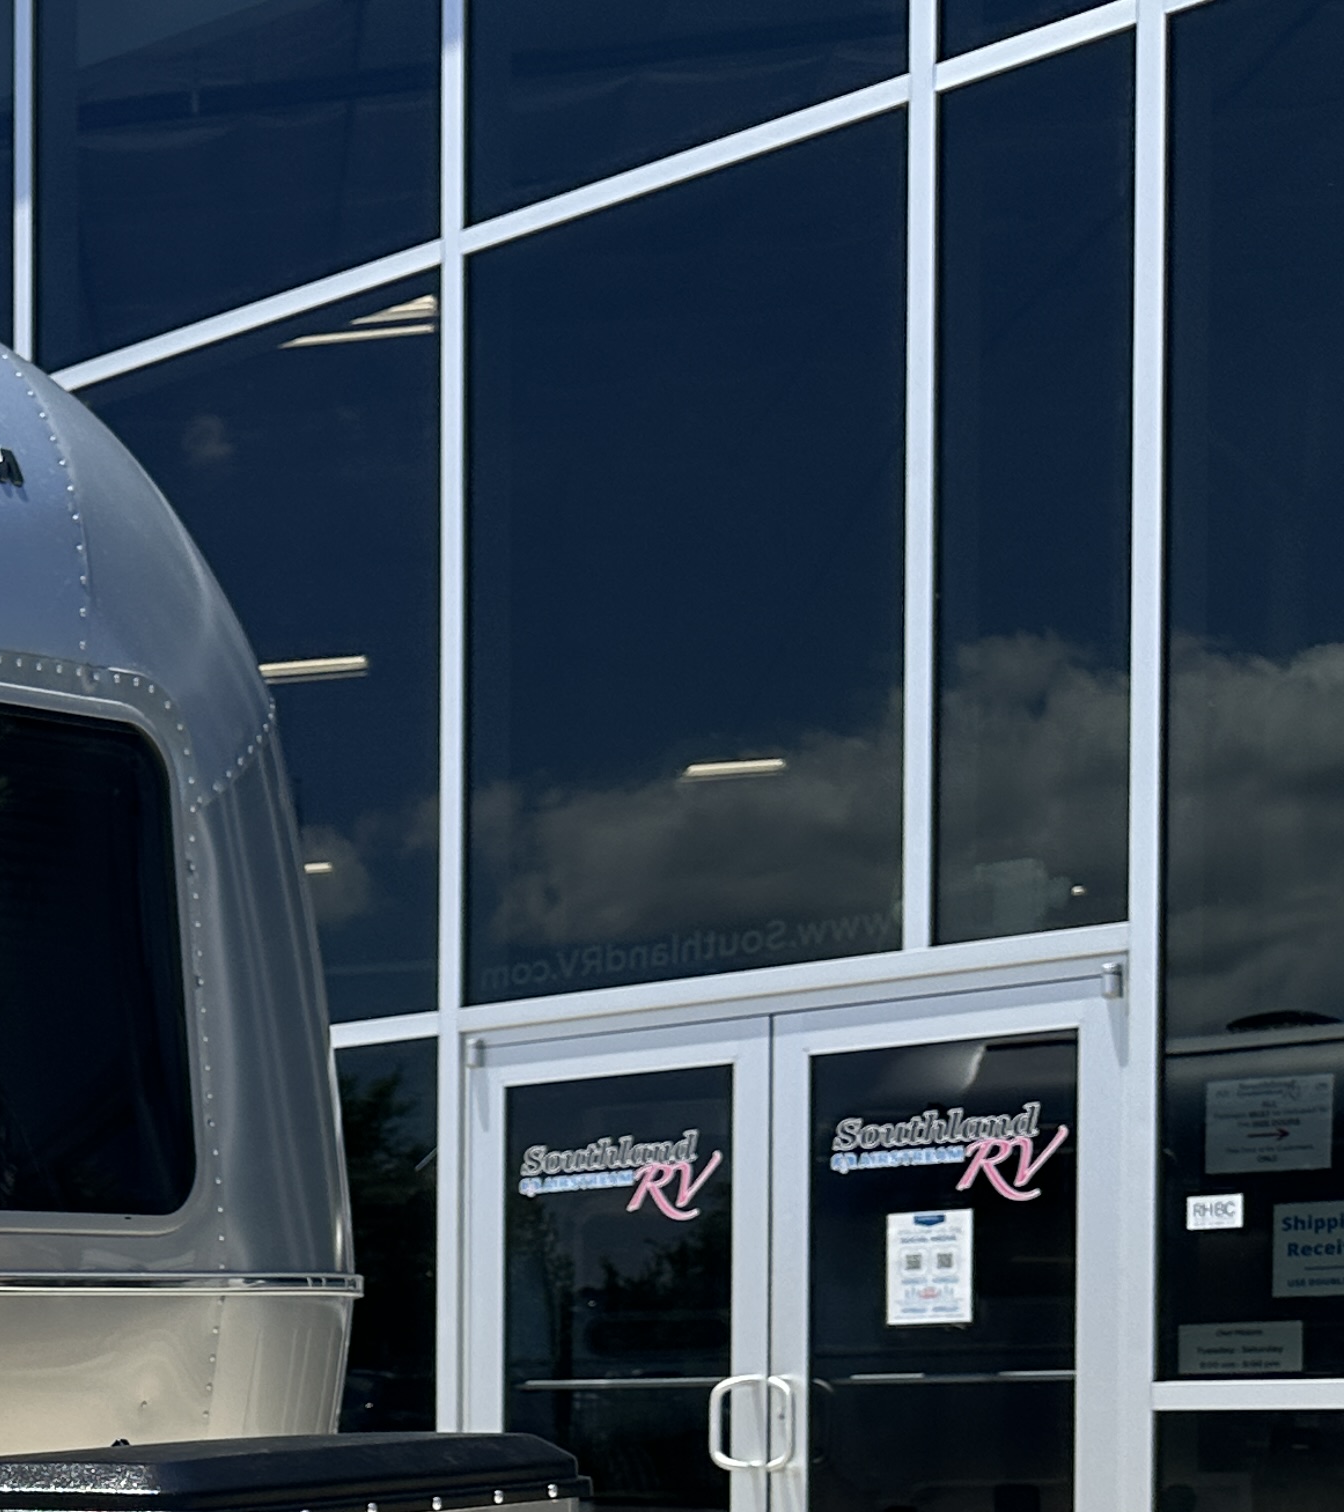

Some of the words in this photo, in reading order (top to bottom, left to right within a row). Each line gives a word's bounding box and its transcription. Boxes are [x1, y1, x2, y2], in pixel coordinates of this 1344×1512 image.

[831, 1101, 1041, 1152] Southland
[520, 1128, 699, 1177] Southland
[956, 1124, 1070, 1201] RV
[626, 1150, 723, 1221] RV
[1287, 1238, 1344, 1257] Recei
[1308, 1277, 1344, 1286] DOUBL
